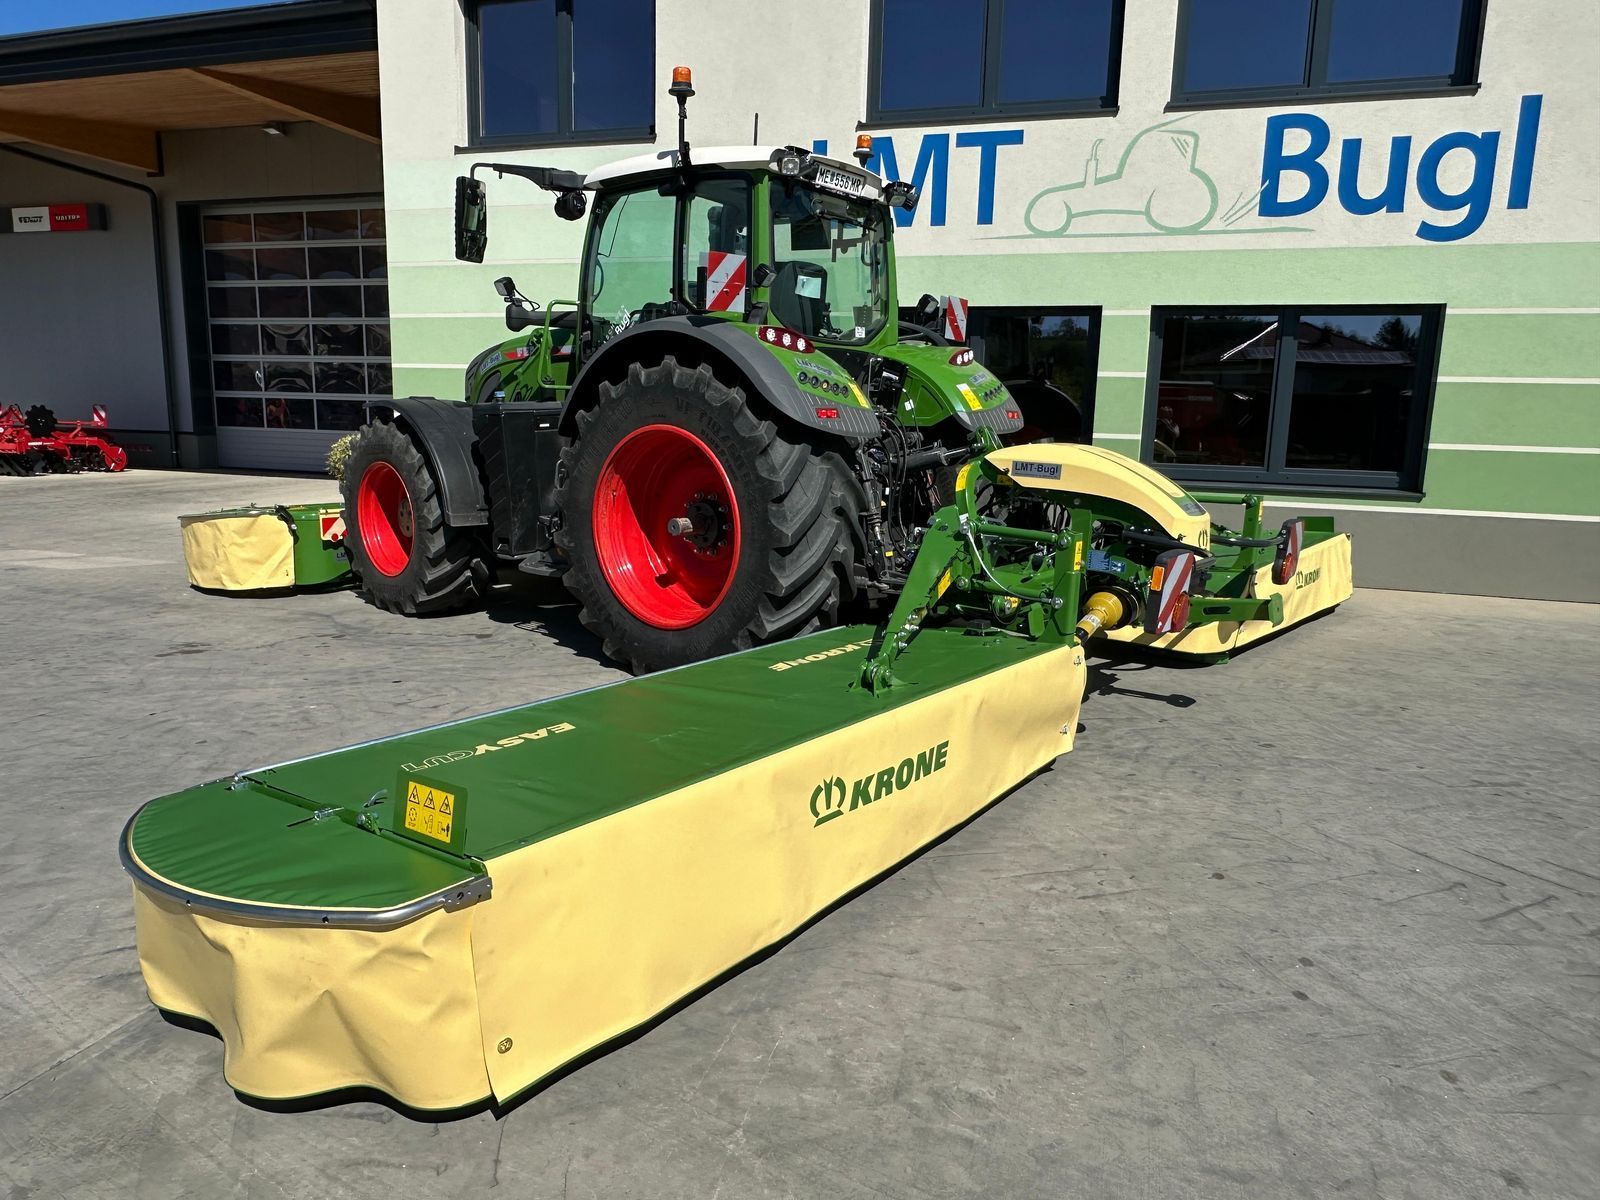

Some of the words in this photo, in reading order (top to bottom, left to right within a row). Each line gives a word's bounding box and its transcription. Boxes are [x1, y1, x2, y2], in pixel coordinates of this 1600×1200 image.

[812, 129, 1025, 228] MT
[1258, 94, 1543, 241] Bugl
[1014, 461, 1060, 475] LMT-Bugl
[768, 643, 862, 672] KRONE
[849, 740, 950, 812] KRONE
